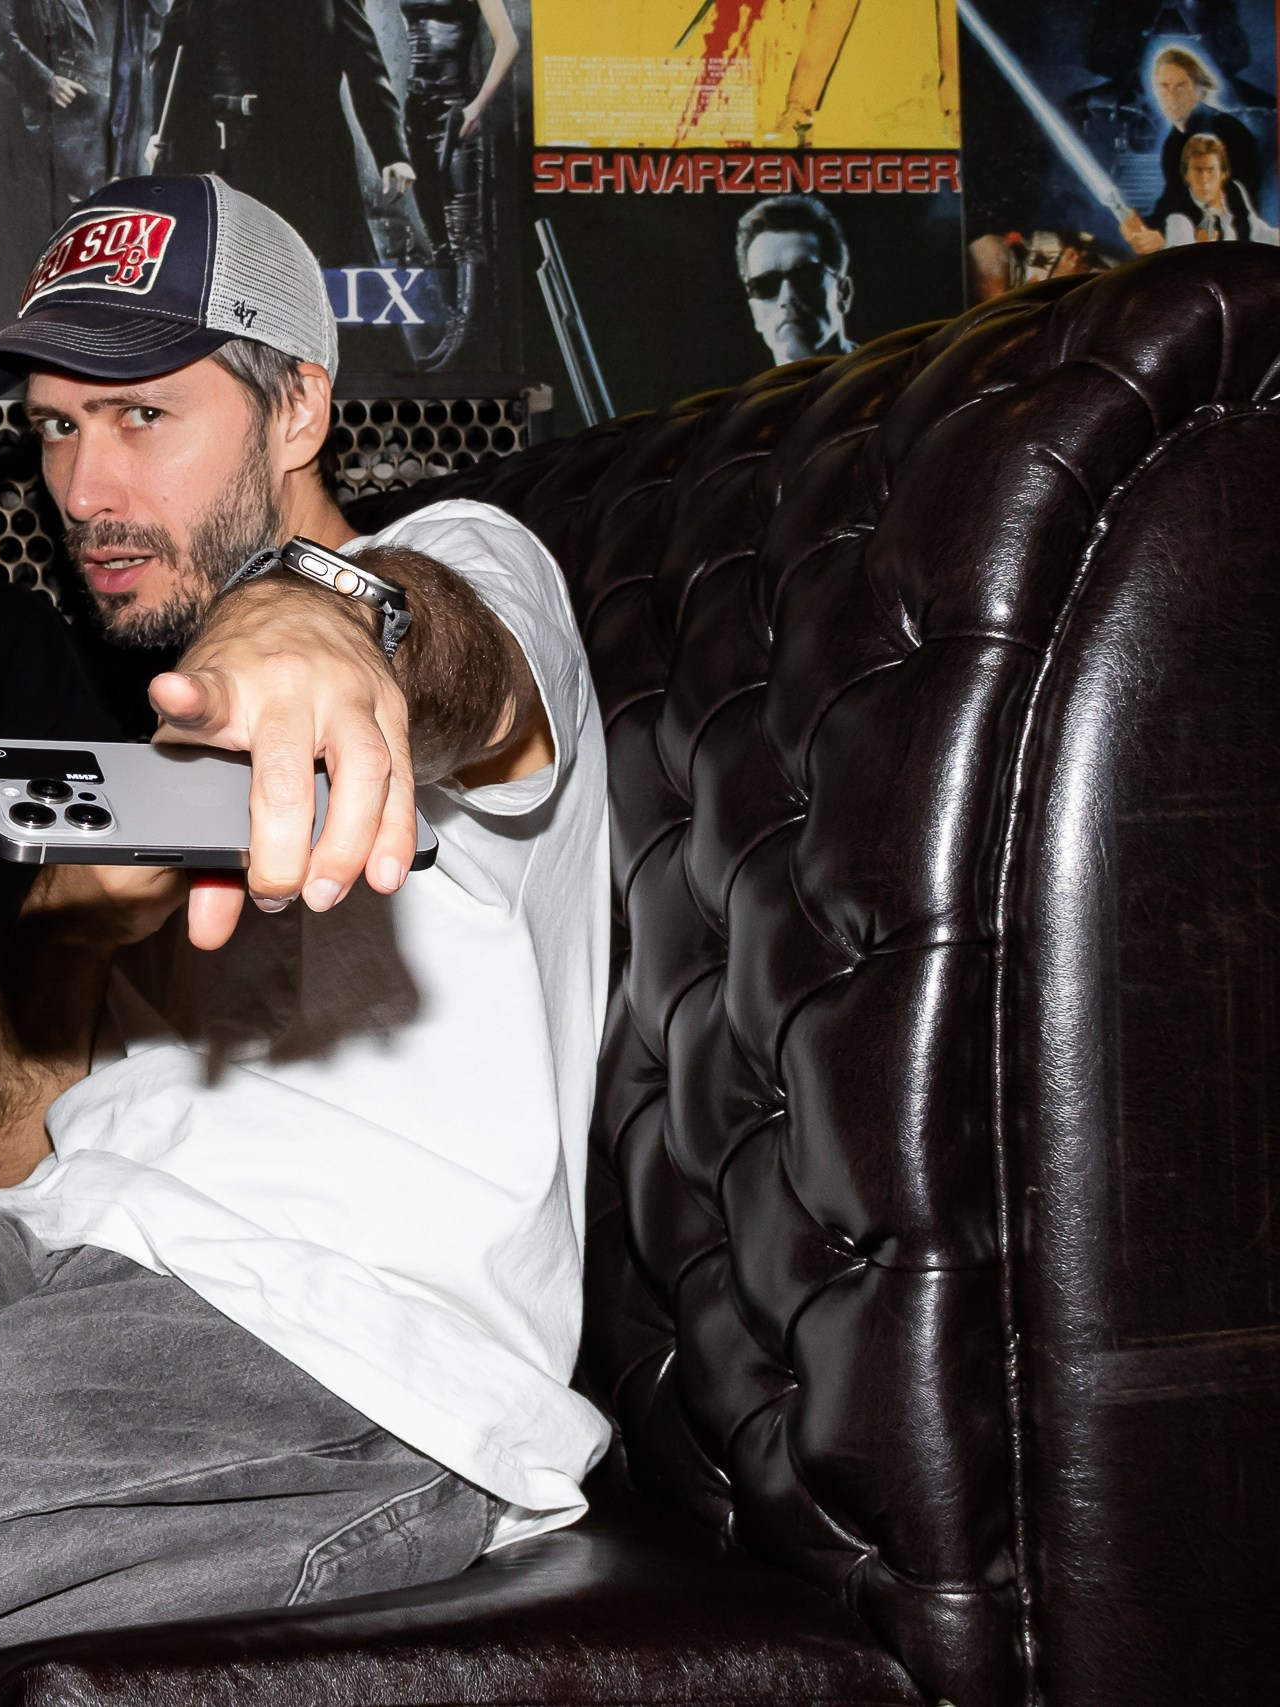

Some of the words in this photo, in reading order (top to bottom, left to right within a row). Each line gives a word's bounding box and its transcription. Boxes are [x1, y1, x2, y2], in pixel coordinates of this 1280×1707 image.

[532, 154, 962, 194] SCHWARZENEGGER
[79, 217, 162, 262] SOX
[104, 244, 148, 286] B
